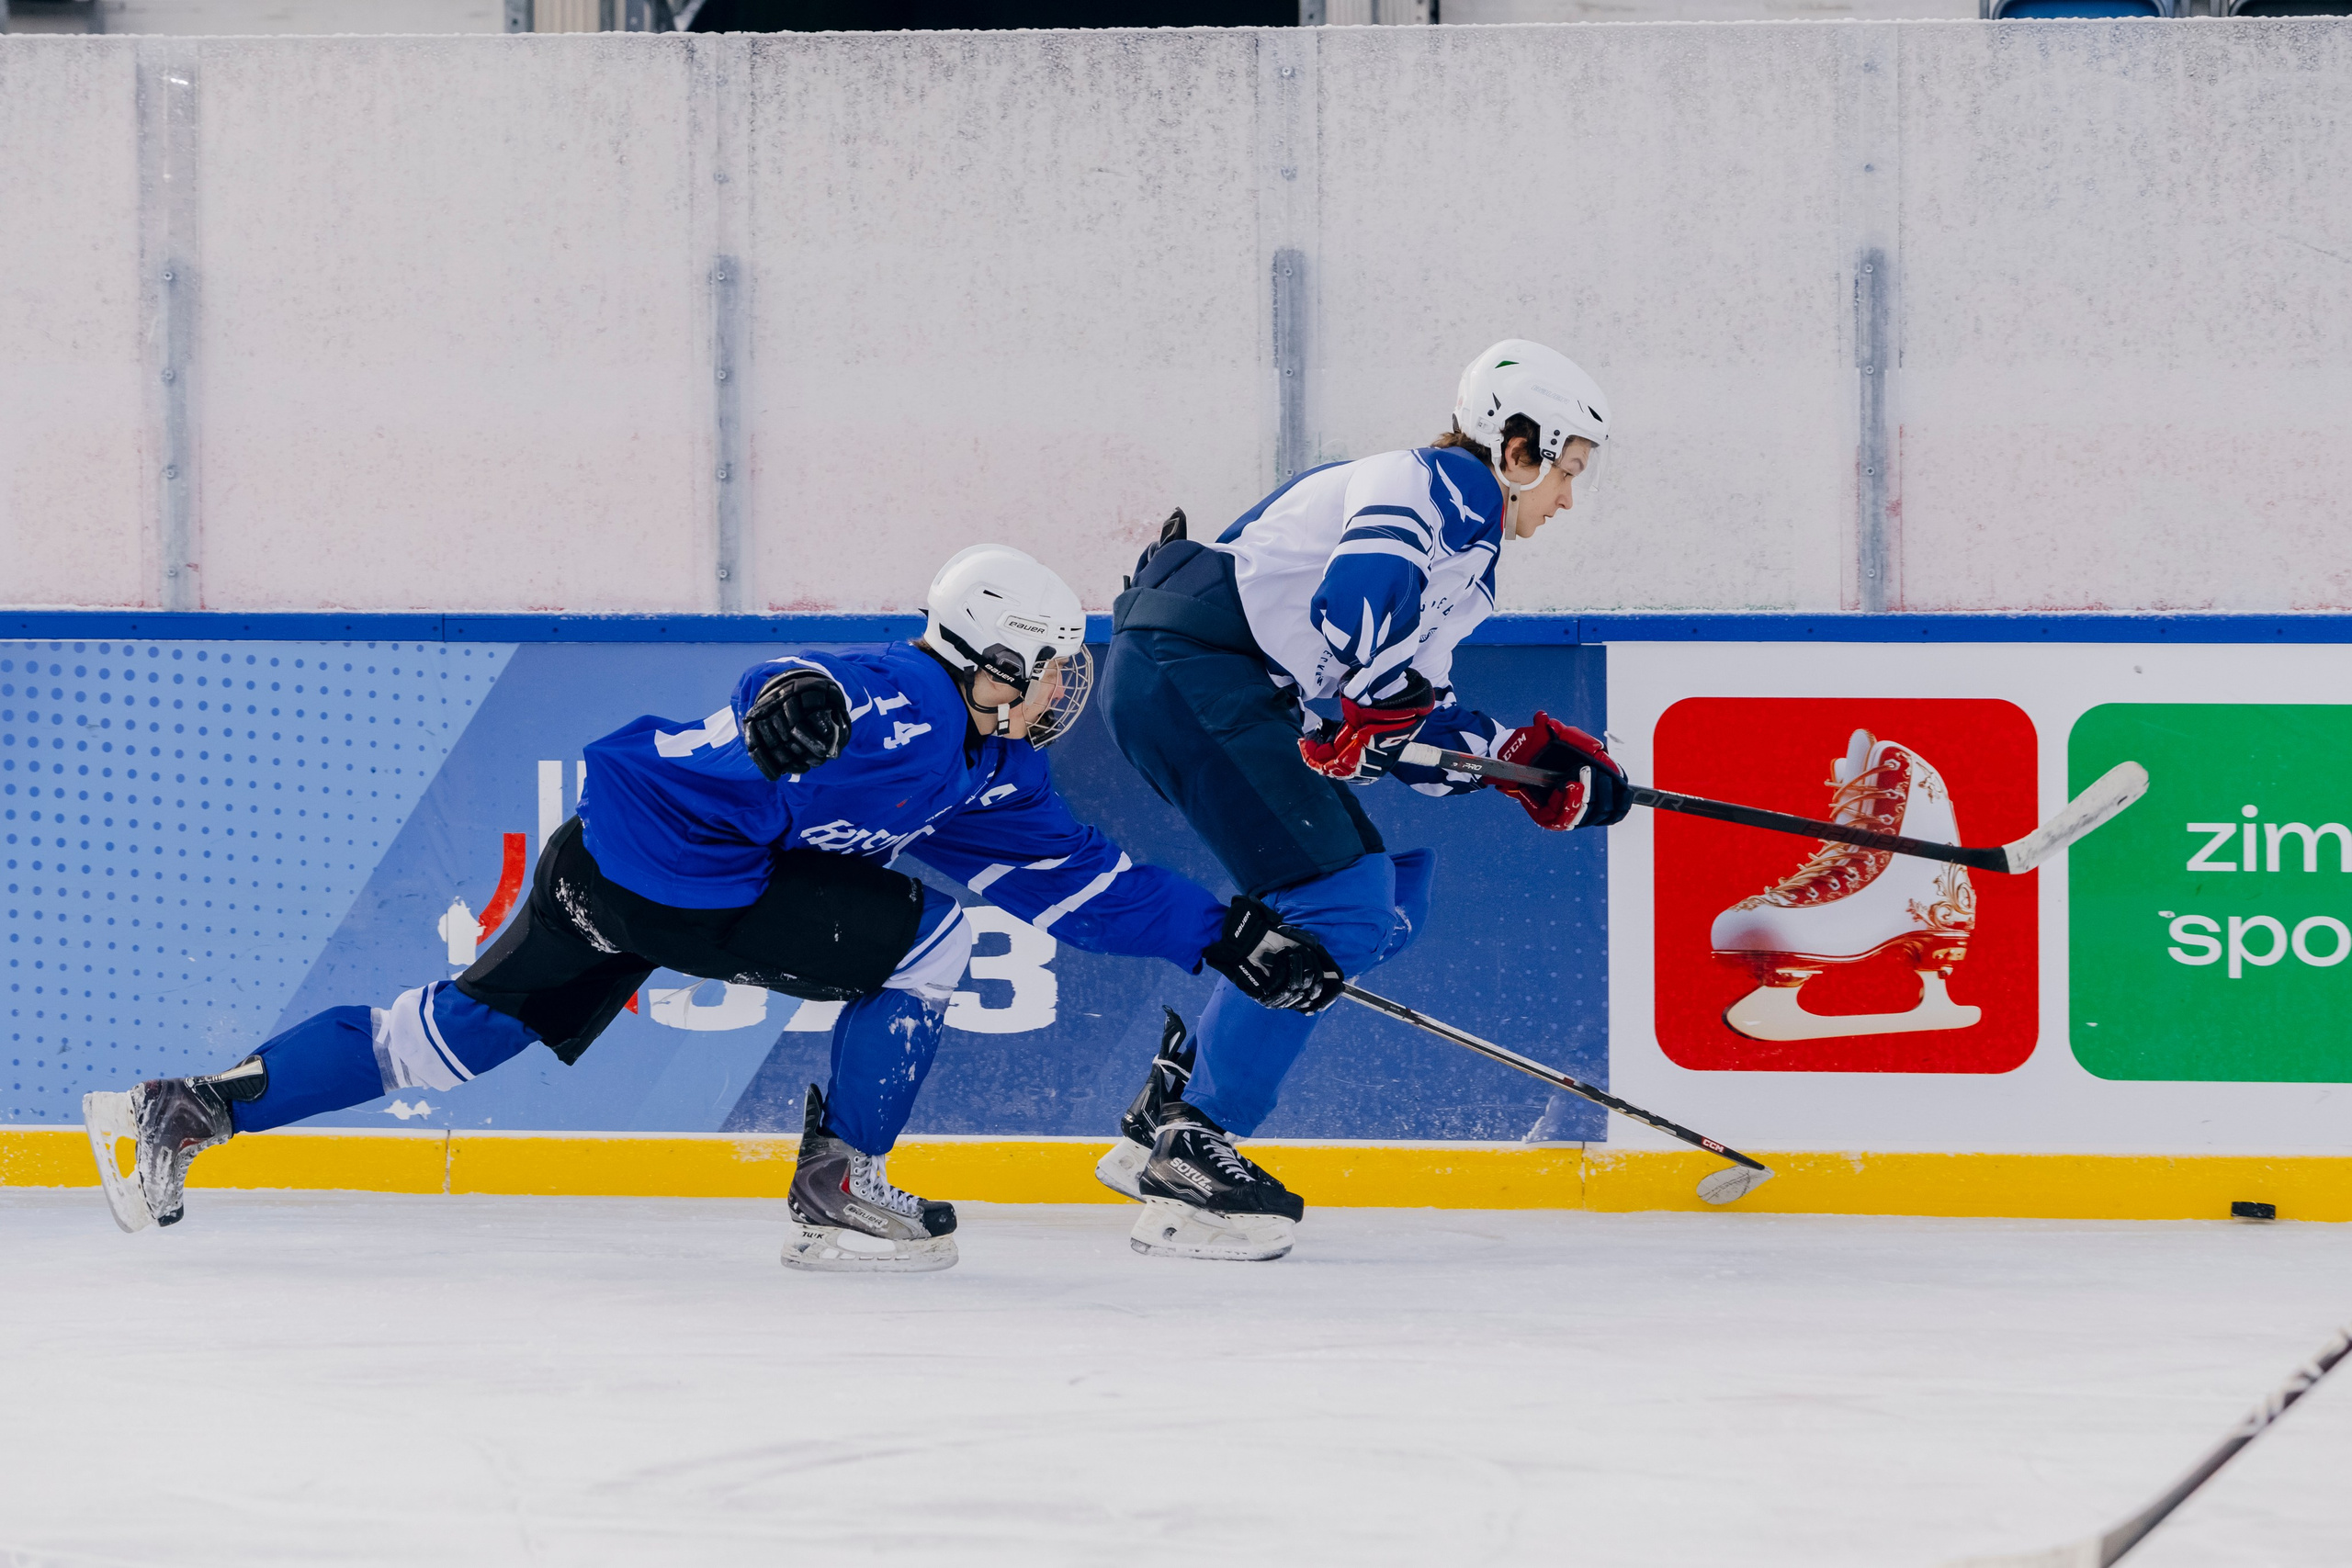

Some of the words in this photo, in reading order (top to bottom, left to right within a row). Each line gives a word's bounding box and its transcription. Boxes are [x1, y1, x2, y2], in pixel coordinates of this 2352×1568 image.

[1009, 620, 1046, 634] BAUER
[984, 663, 1015, 682] BAUER
[1502, 732, 1527, 761] CCM
[2186, 804, 2352, 873] zim
[1234, 910, 1251, 939] BAUER
[2167, 914, 2352, 979] spo
[1238, 964, 1260, 987] BAUER
[1702, 1138, 1724, 1153] CCM
[1170, 1156, 1213, 1188] SOYUZ
[848, 1205, 883, 1225] BAUER
